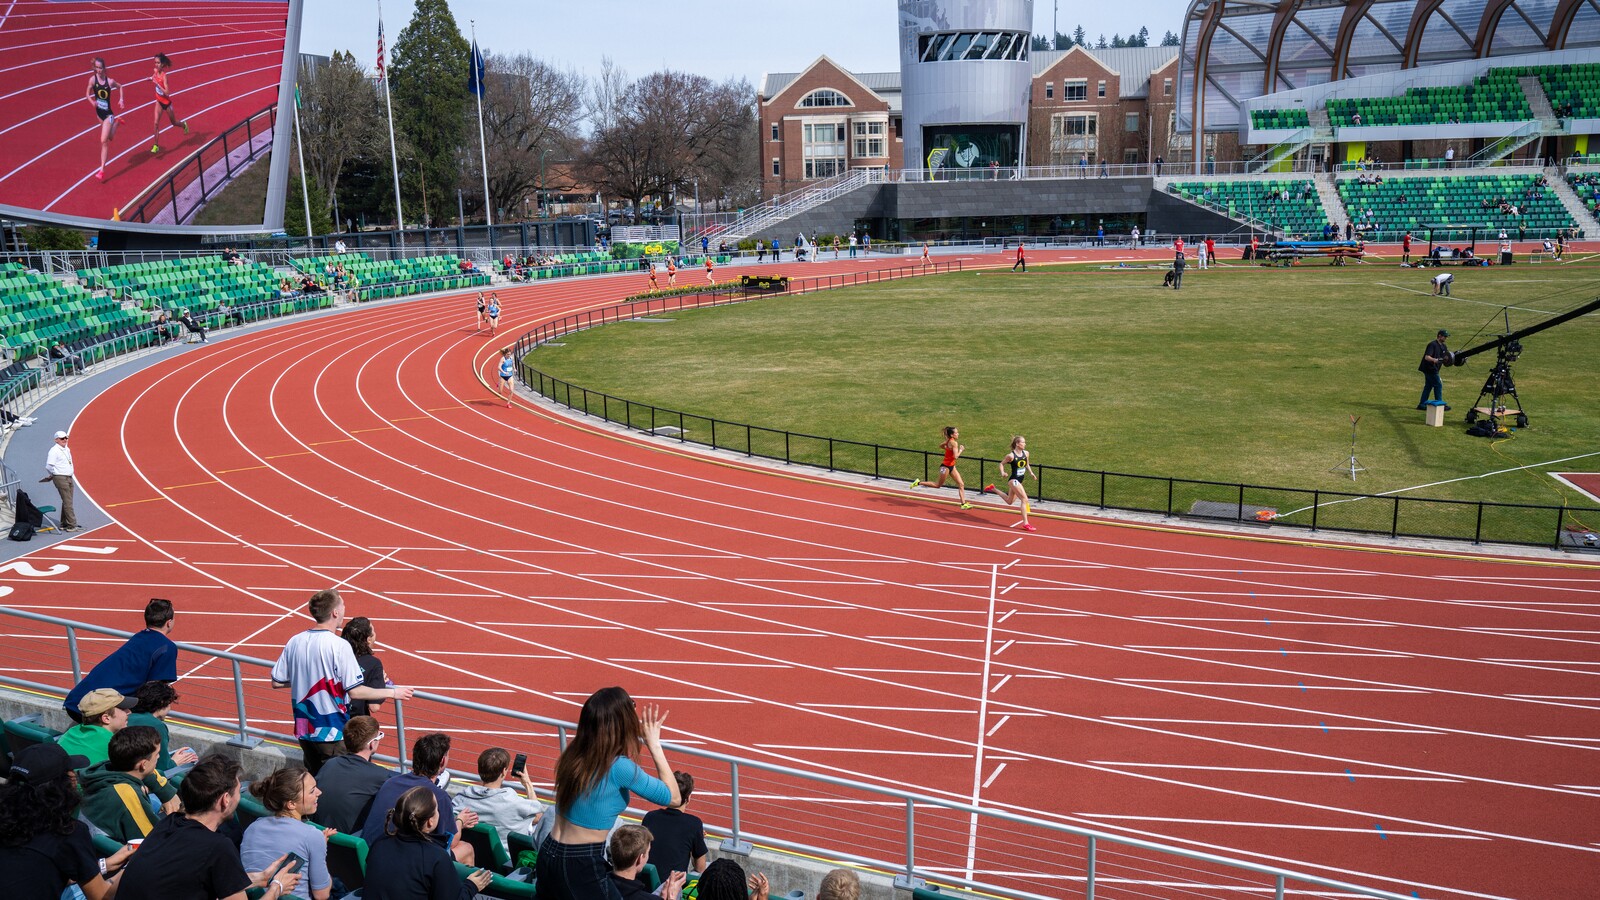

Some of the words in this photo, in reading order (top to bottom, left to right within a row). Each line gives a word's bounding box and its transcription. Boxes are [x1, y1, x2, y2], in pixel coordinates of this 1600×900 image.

[98, 89, 108, 99] O
[1017, 460, 1026, 468] O
[51, 545, 119, 554] 1
[0, 562, 70, 576] 2
